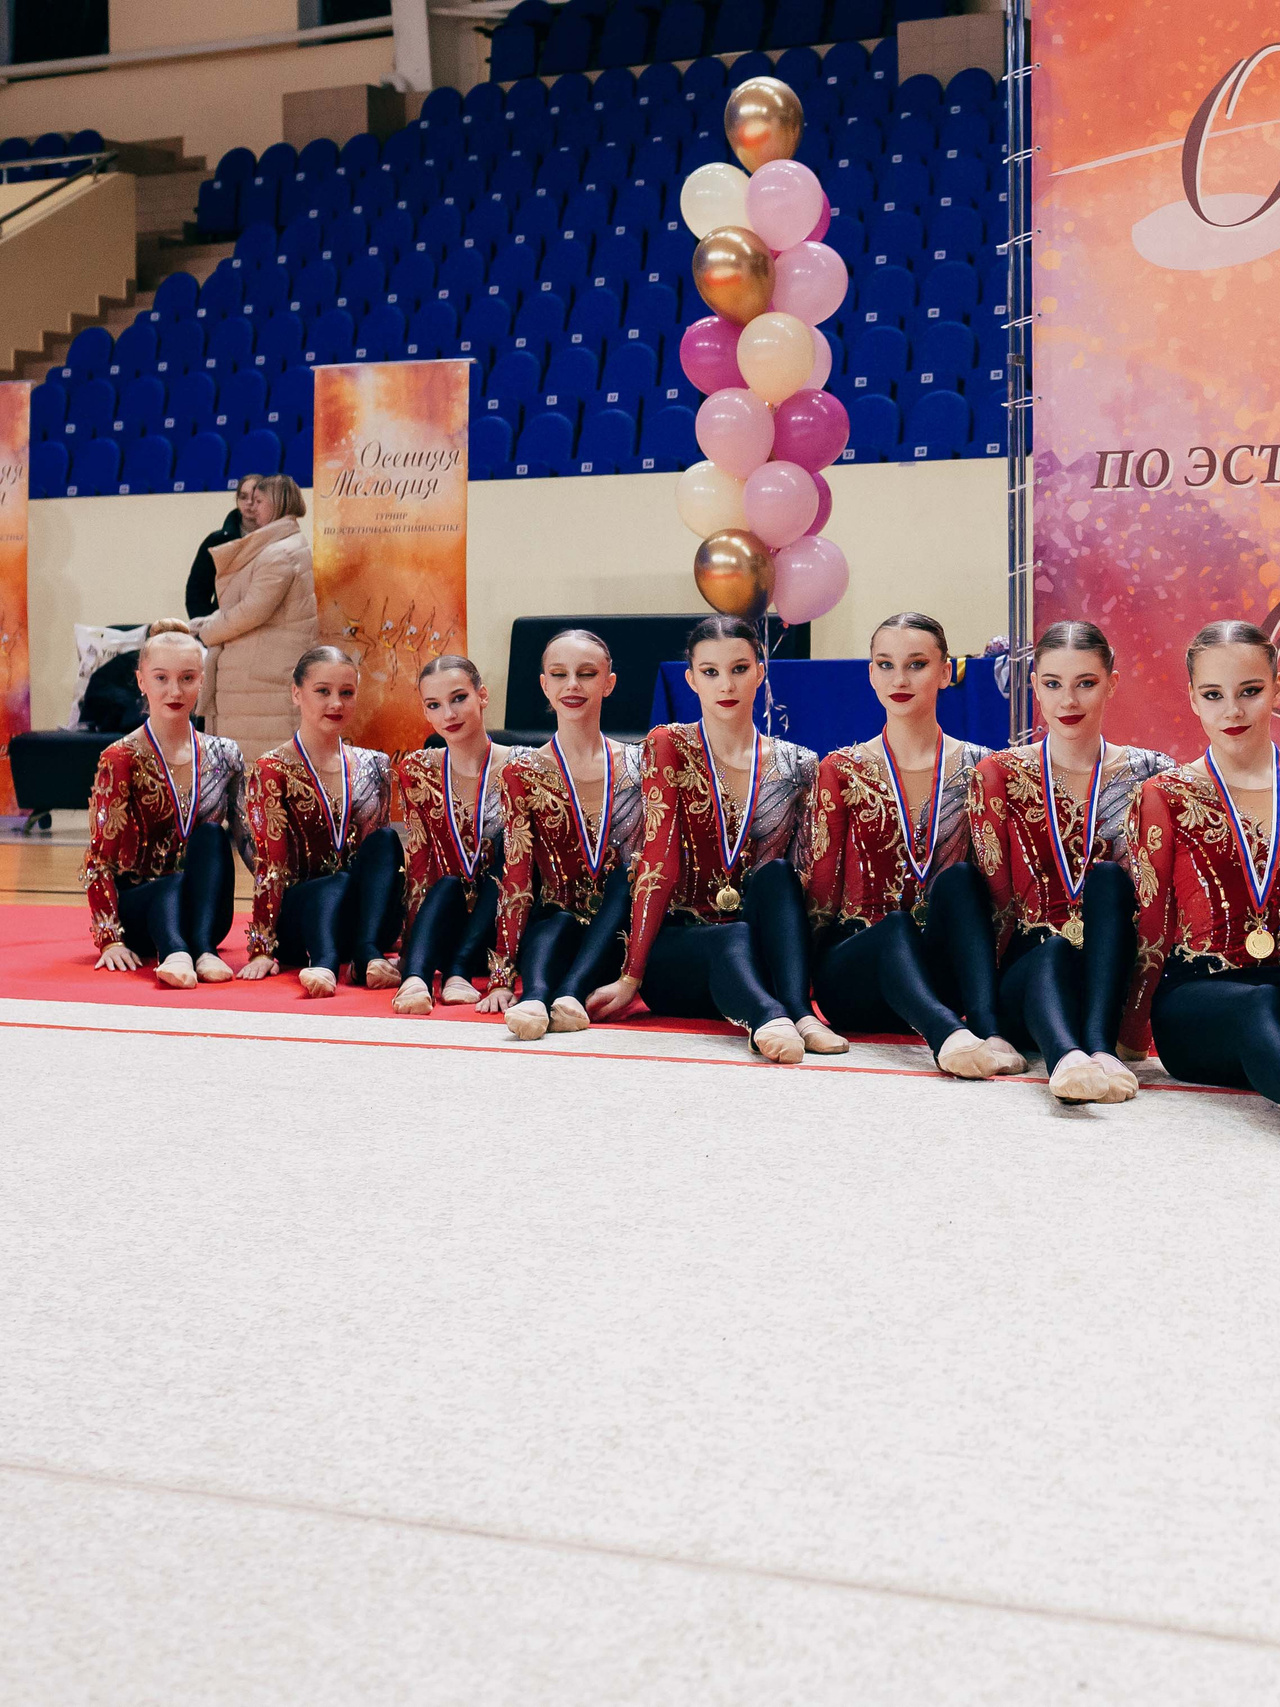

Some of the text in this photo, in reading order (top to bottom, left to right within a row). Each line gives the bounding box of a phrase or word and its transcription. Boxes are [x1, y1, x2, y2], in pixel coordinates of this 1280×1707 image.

[360, 440, 462, 472] Осенняя
[1091, 445, 1172, 492] ПО
[321, 468, 441, 501] Мелодия
